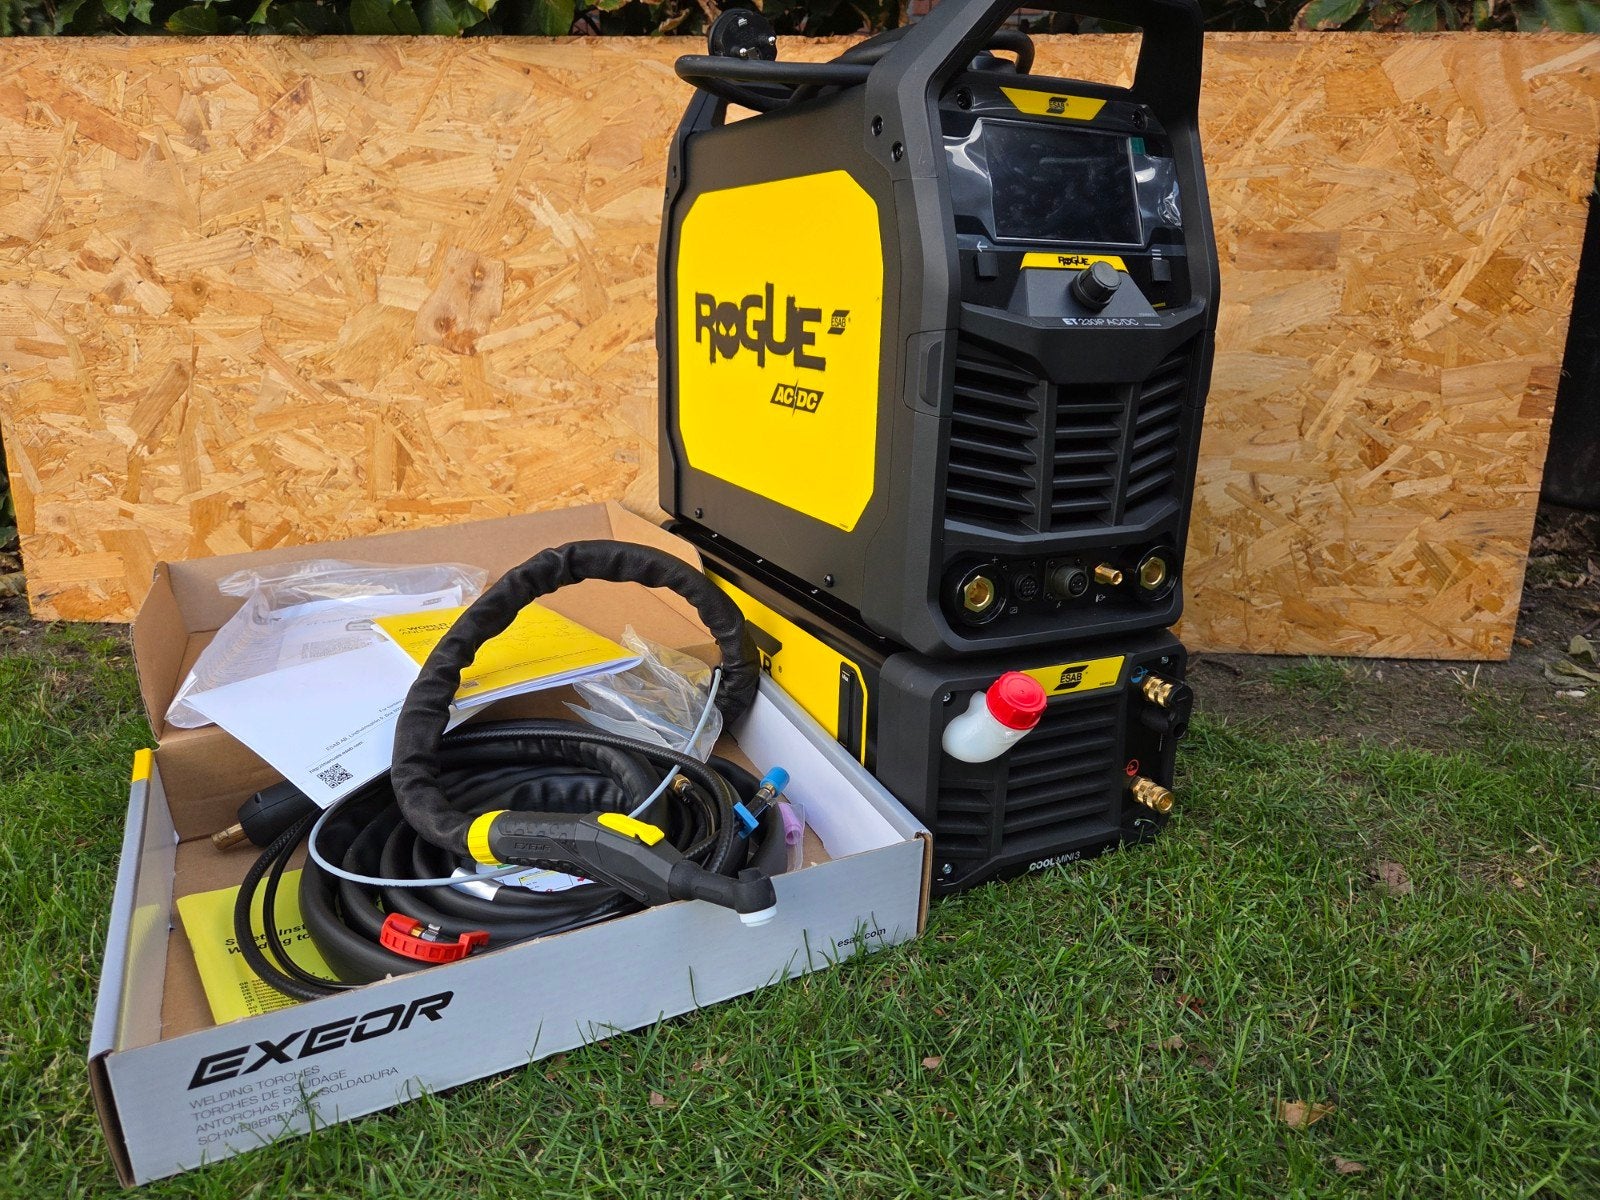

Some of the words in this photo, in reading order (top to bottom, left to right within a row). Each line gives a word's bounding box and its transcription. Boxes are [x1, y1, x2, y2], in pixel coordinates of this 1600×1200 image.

[1058, 256, 1090, 266] ROGUE
[695, 281, 826, 372] ROGUE
[831, 316, 846, 328] ESAB
[1062, 317, 1079, 326] ET
[1060, 672, 1083, 684] ESAB
[187, 990, 454, 1091] EXEOR
[190, 1084, 254, 1110] WELDING
[255, 1065, 321, 1091] TORCHES
[193, 1095, 259, 1122] TORCHES
[261, 1089, 280, 1102] DE
[283, 1069, 348, 1095] SOUDAGE
[195, 1103, 280, 1135] ANTORCHAS
[321, 1066, 399, 1096] SOLDADURA
